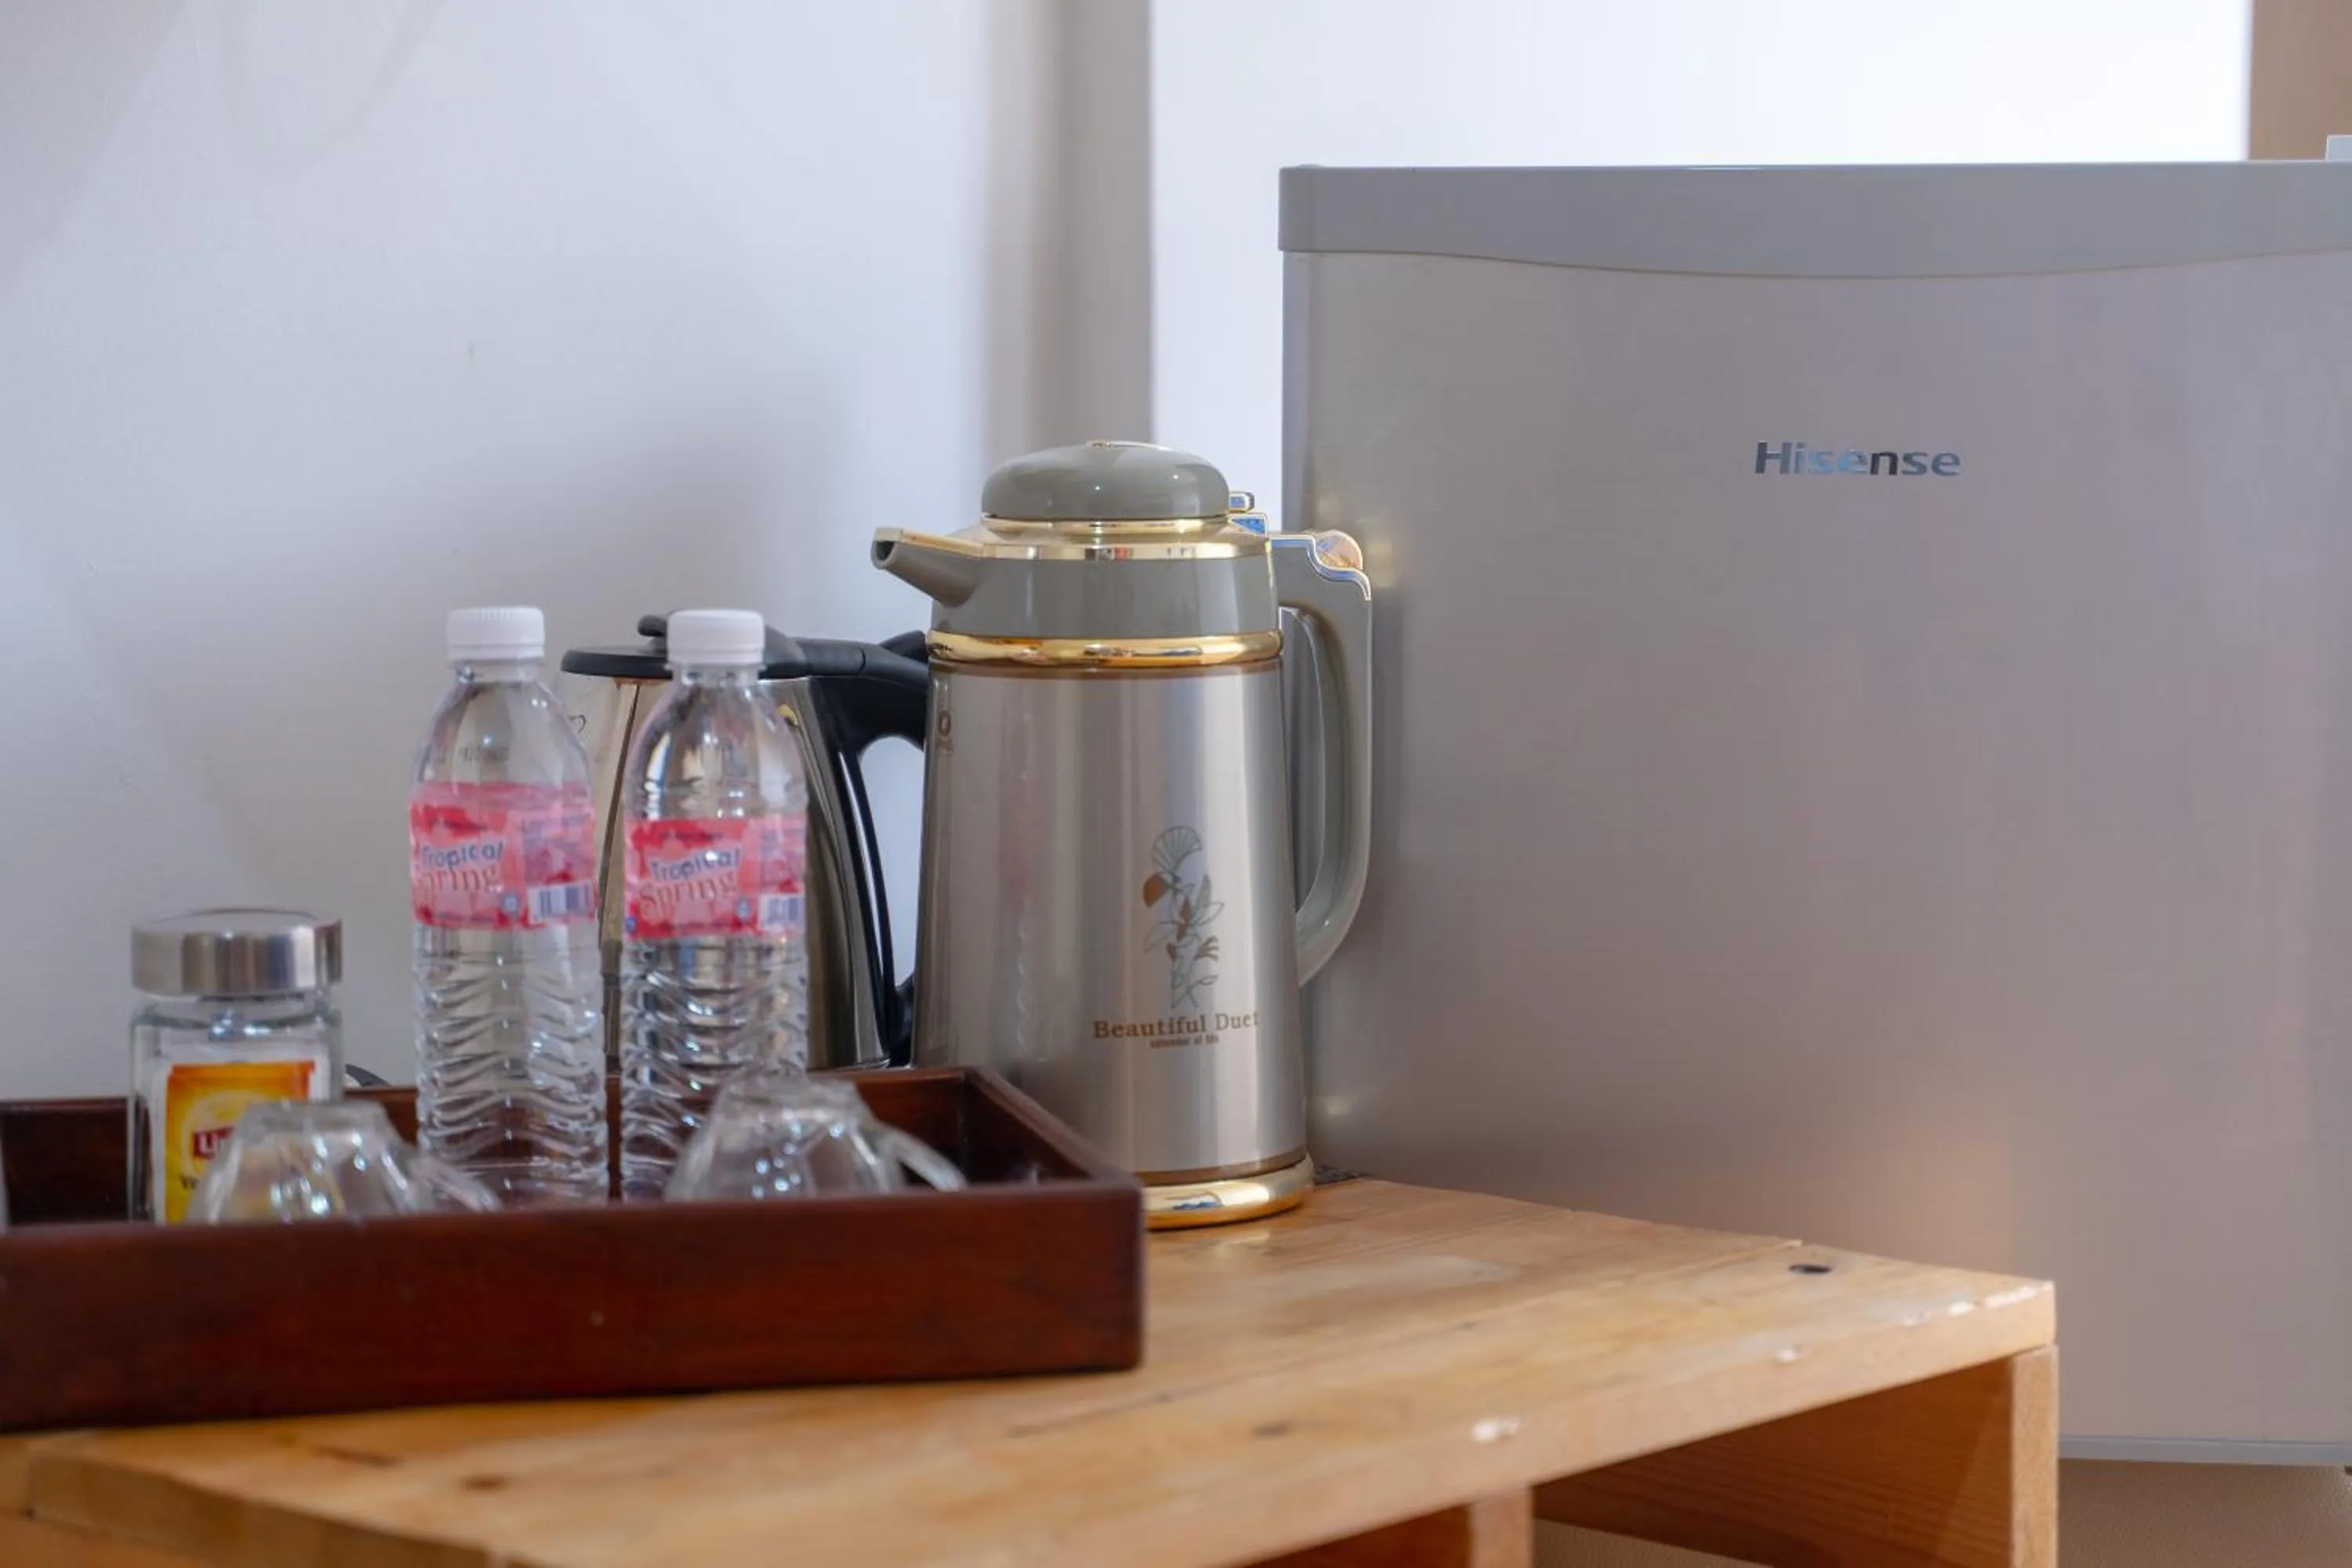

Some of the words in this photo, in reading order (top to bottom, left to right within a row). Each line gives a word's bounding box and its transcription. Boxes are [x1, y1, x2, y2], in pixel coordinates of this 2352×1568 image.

[1755, 441, 1961, 476] Hisense
[422, 840, 504, 870] Tropical
[651, 848, 741, 881] Tropical
[639, 871, 737, 916] Spring
[1093, 1014, 1207, 1039] Beautiful
[1214, 1010, 1260, 1031] Duet
